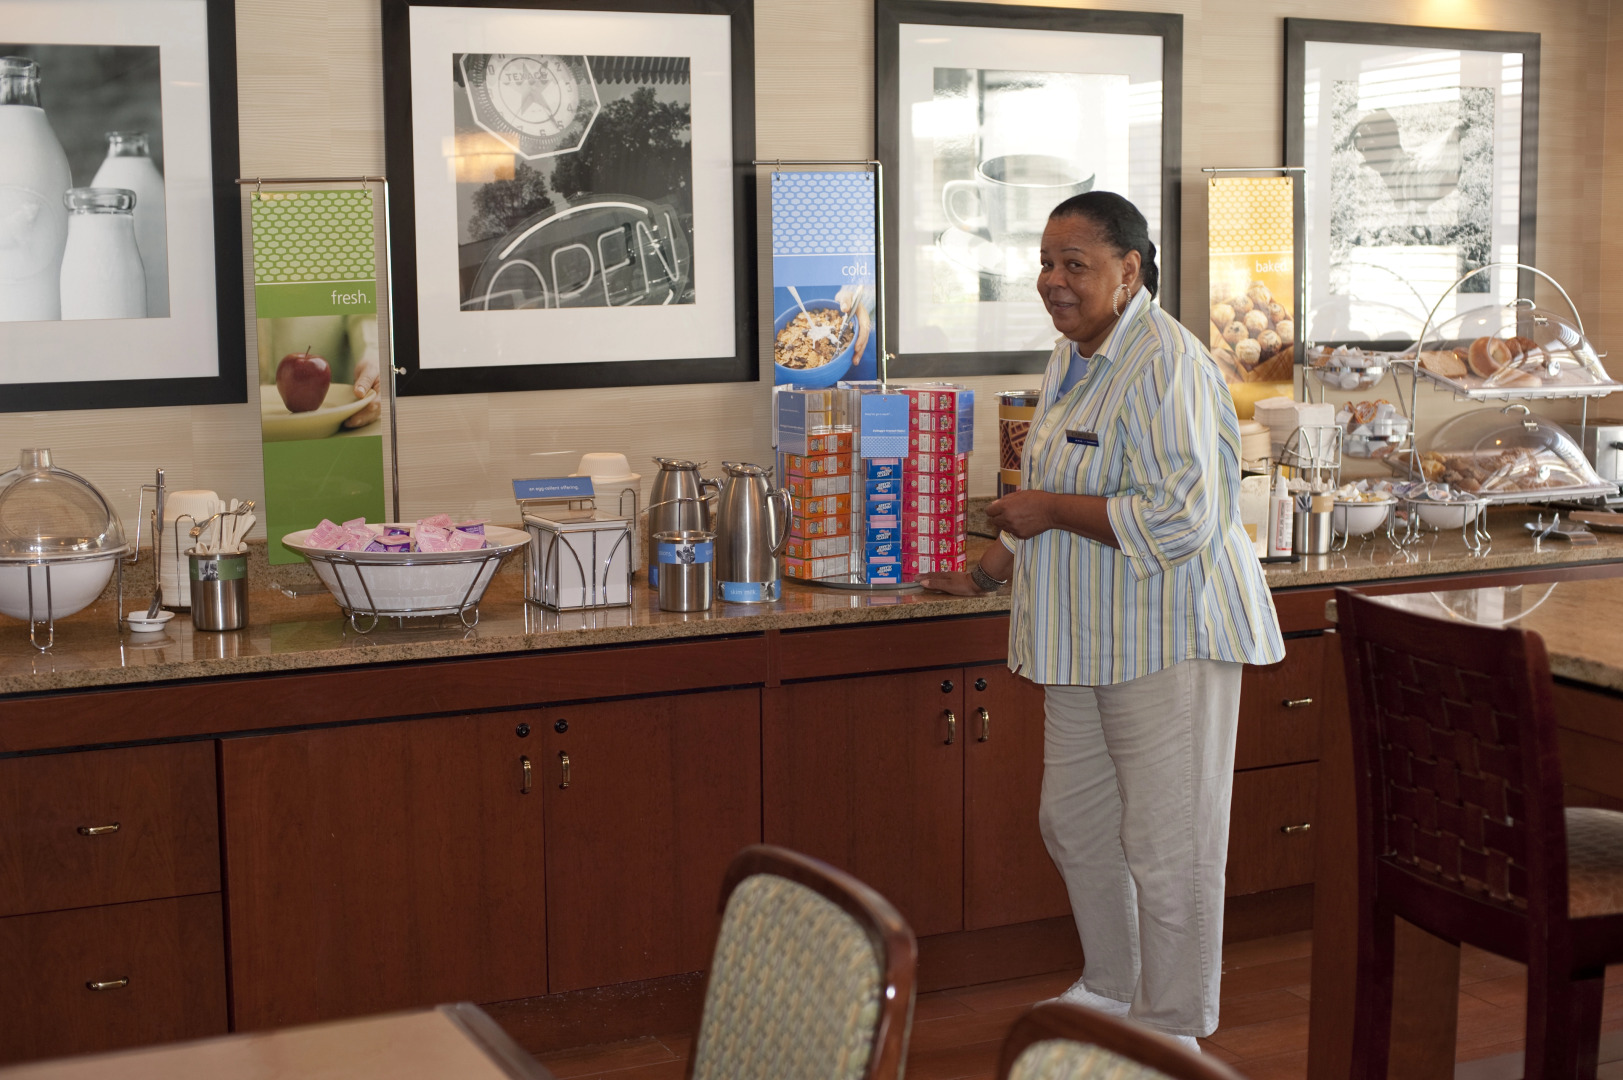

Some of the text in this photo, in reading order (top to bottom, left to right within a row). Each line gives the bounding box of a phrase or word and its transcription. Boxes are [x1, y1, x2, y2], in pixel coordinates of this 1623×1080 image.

[505, 71, 549, 82] TEXACO
[485, 212, 679, 309] OPEN
[841, 261, 871, 276] cold.
[331, 289, 371, 305] fresh.
